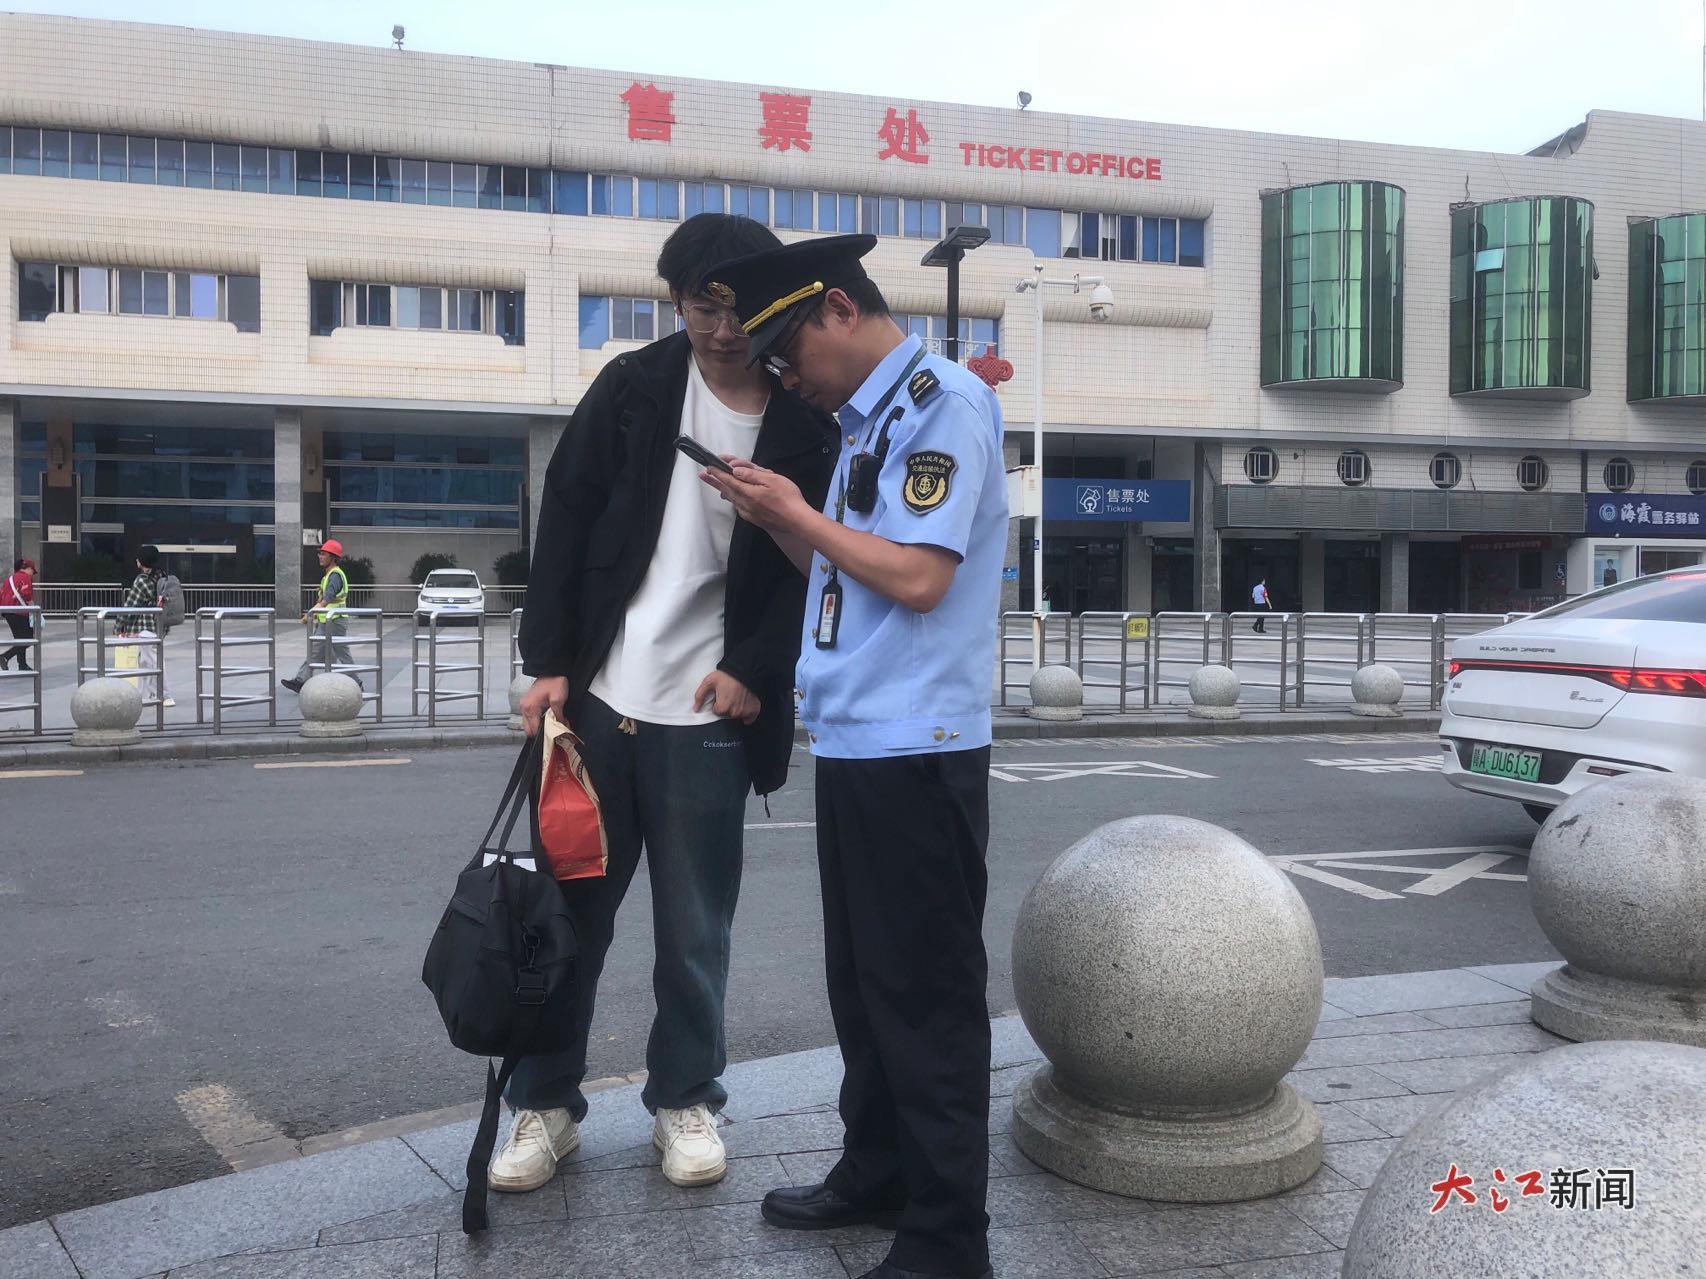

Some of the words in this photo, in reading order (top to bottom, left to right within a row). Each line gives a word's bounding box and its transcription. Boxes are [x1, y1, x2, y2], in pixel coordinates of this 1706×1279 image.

[619, 81, 929, 165] 售票处
[1106, 488, 1150, 504] 售票处
[1106, 504, 1133, 513] Tickets
